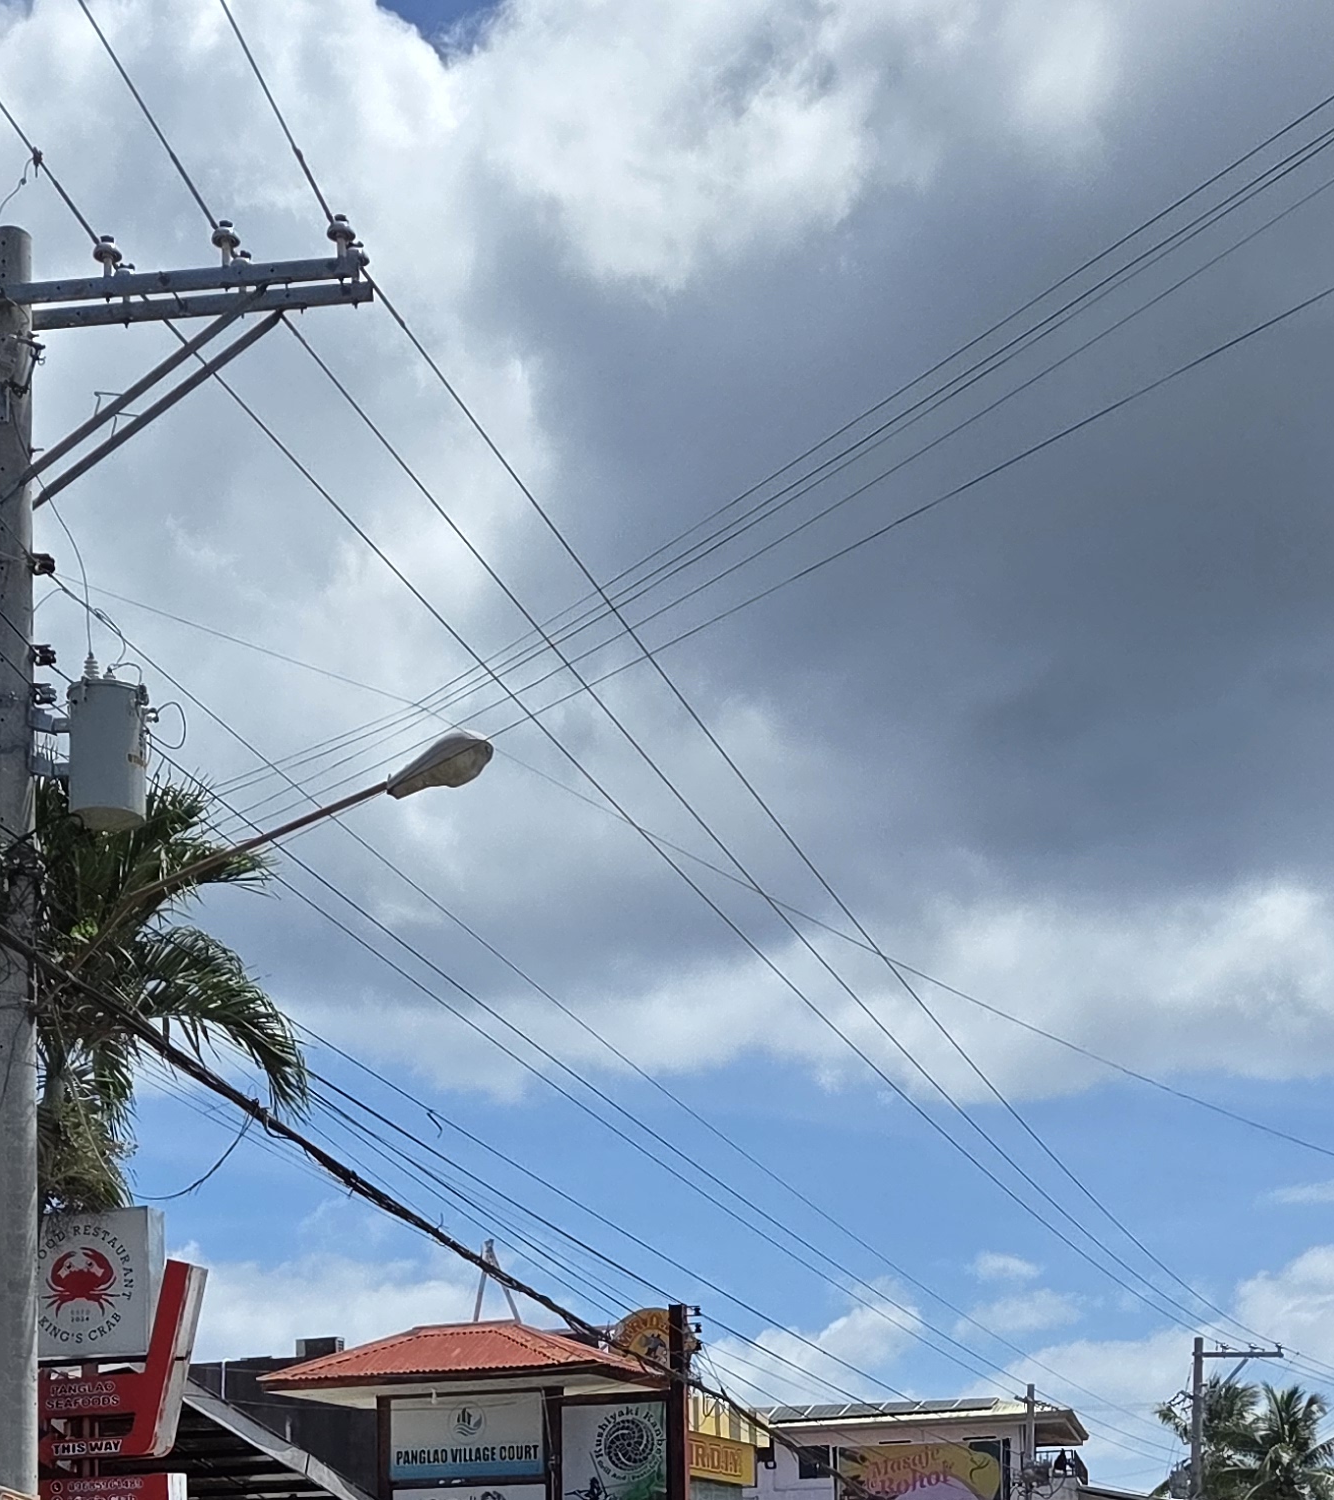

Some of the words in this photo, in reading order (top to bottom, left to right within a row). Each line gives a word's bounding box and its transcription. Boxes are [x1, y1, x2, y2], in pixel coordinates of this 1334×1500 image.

[73, 1225, 134, 1301] RESTAURANT
[38, 1316, 83, 1344] KING'S
[88, 1312, 121, 1342] CRAB
[51, 1381, 116, 1396] PANGLAO
[46, 1395, 120, 1410] SEAFOODS
[594, 1406, 639, 1459] Kushiyaki
[52, 1442, 86, 1455] THIS
[88, 1440, 122, 1453] WAY
[396, 1450, 448, 1466] PANGLAO
[450, 1447, 496, 1464] VILLAGE
[499, 1445, 539, 1461] COURT
[871, 1446, 940, 1478] Masaje
